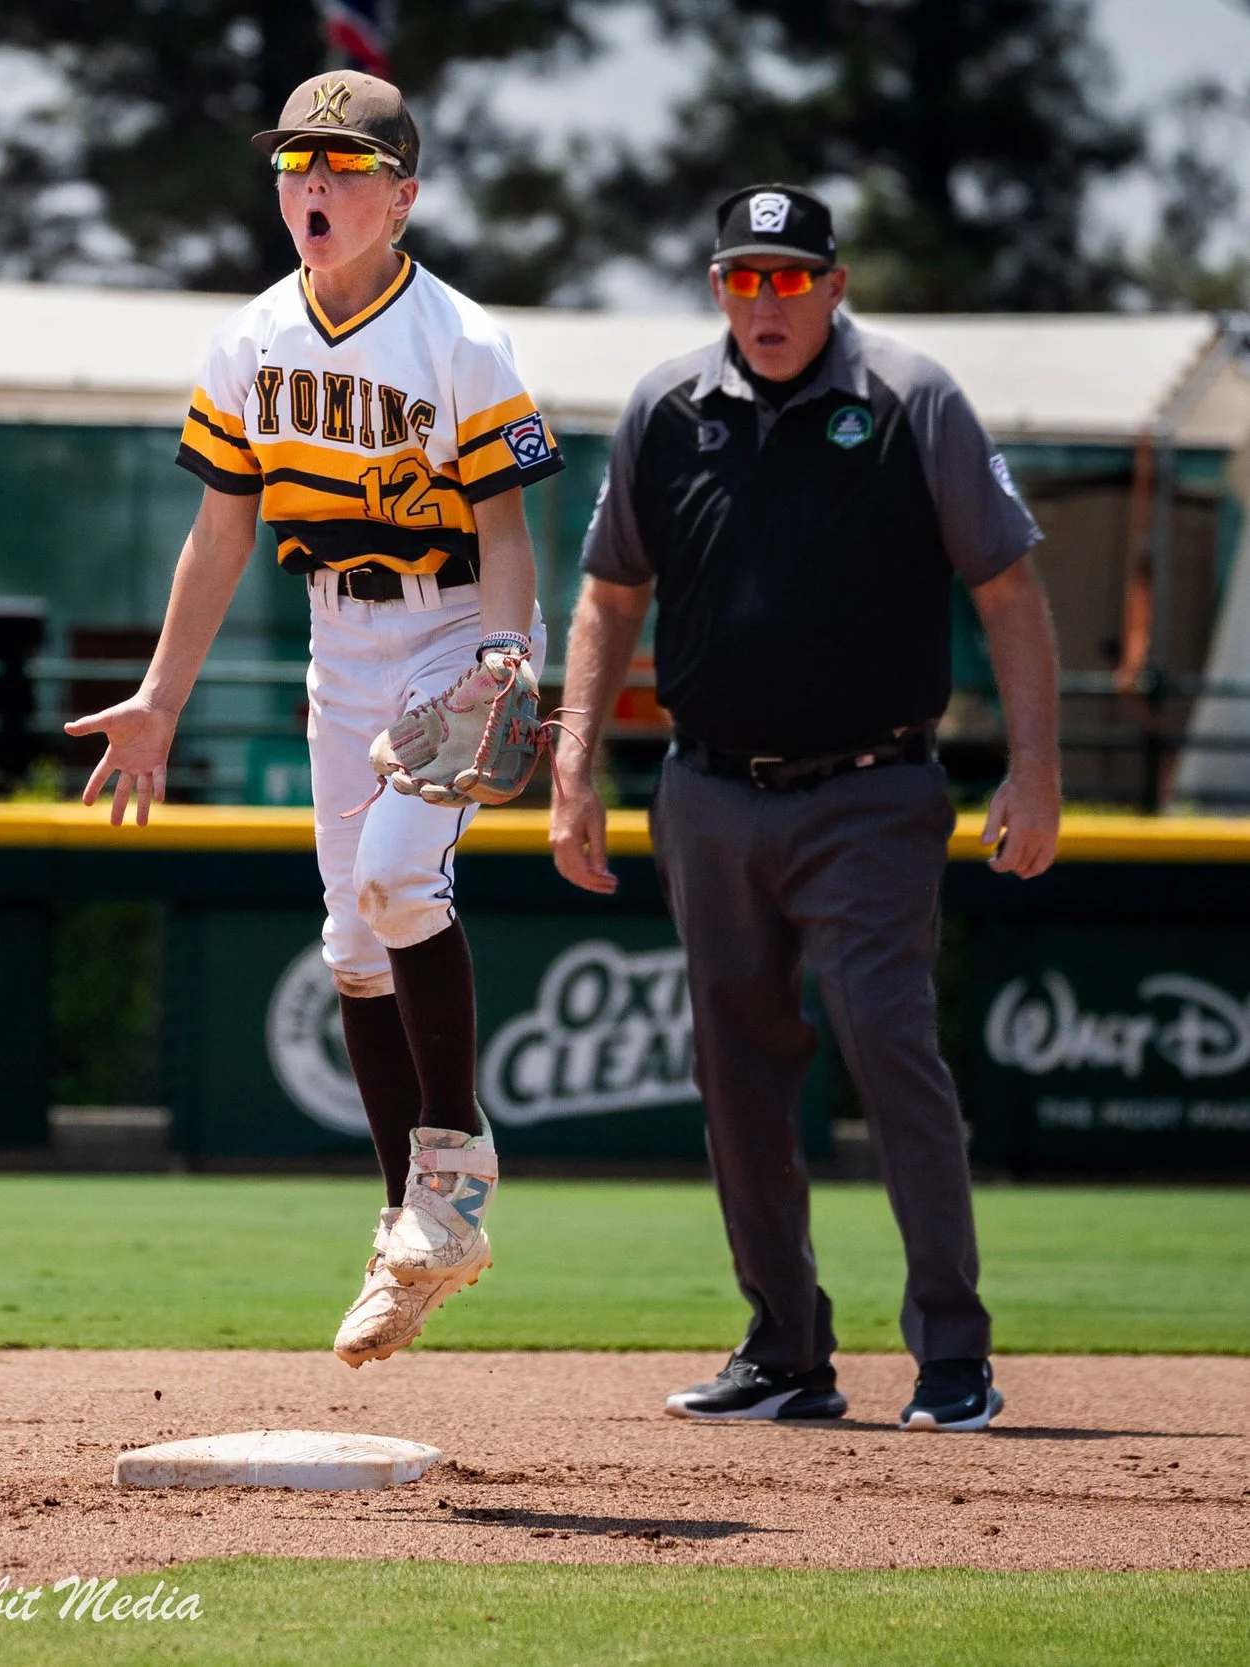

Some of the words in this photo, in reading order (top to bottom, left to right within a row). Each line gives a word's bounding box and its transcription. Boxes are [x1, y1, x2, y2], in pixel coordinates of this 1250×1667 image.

[254, 365, 436, 450] YOMING
[358, 456, 443, 532] 12
[500, 1030, 696, 1107] CLEA
